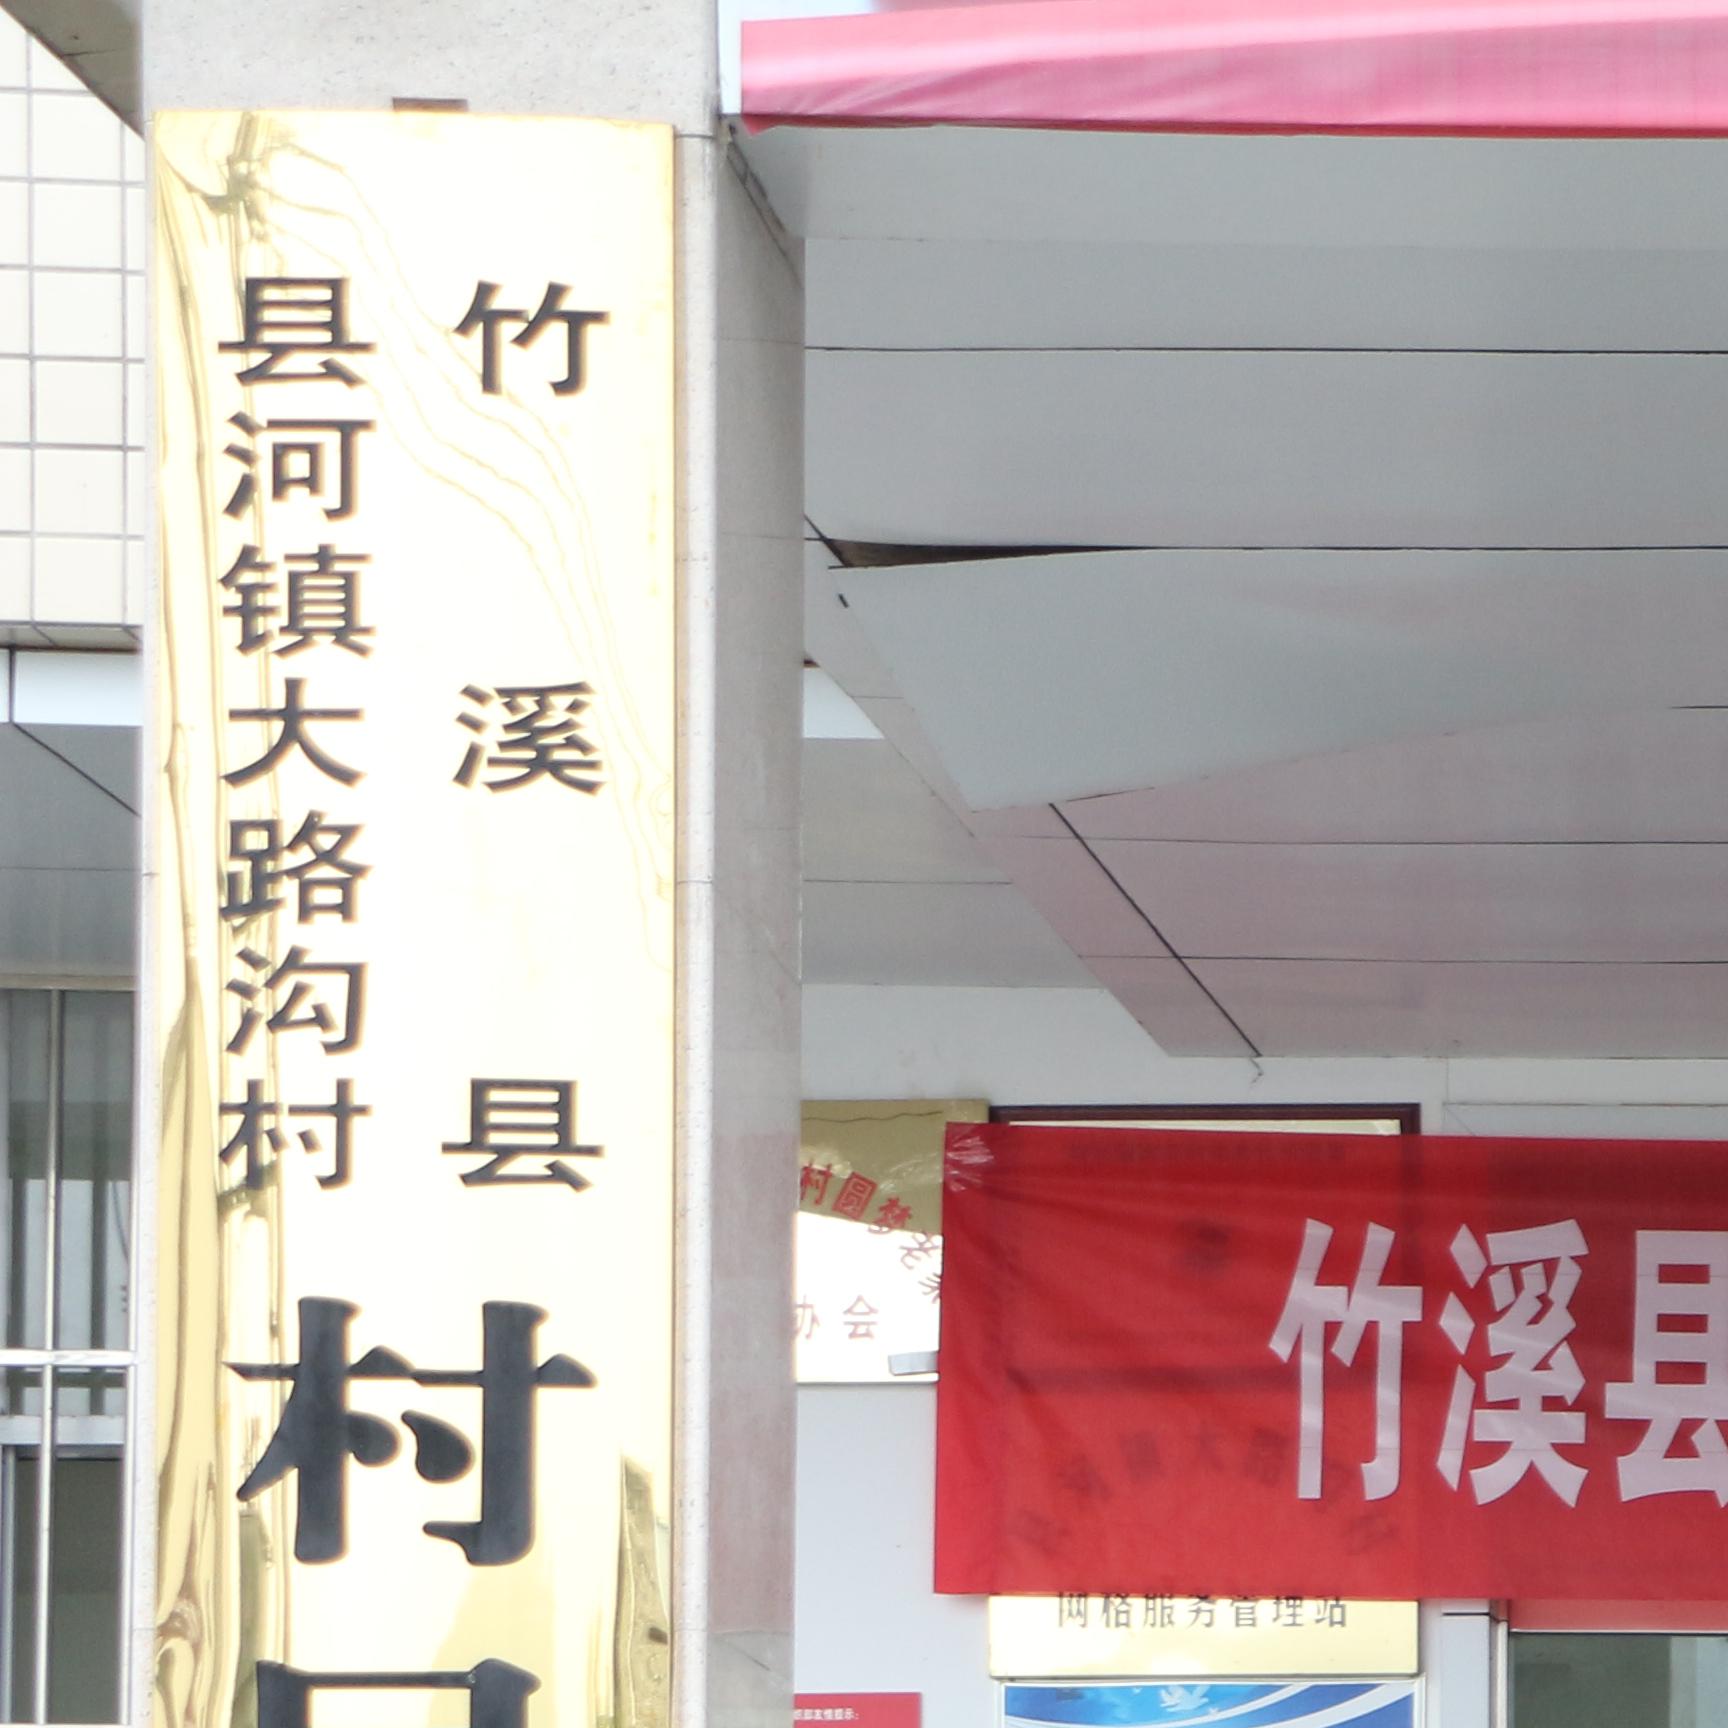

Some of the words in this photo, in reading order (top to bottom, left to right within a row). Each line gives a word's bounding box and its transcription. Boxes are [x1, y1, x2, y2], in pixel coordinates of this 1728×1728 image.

[217, 274, 375, 1189] 县河镇大路沟村
[440, 279, 609, 1189] 竹溪县
